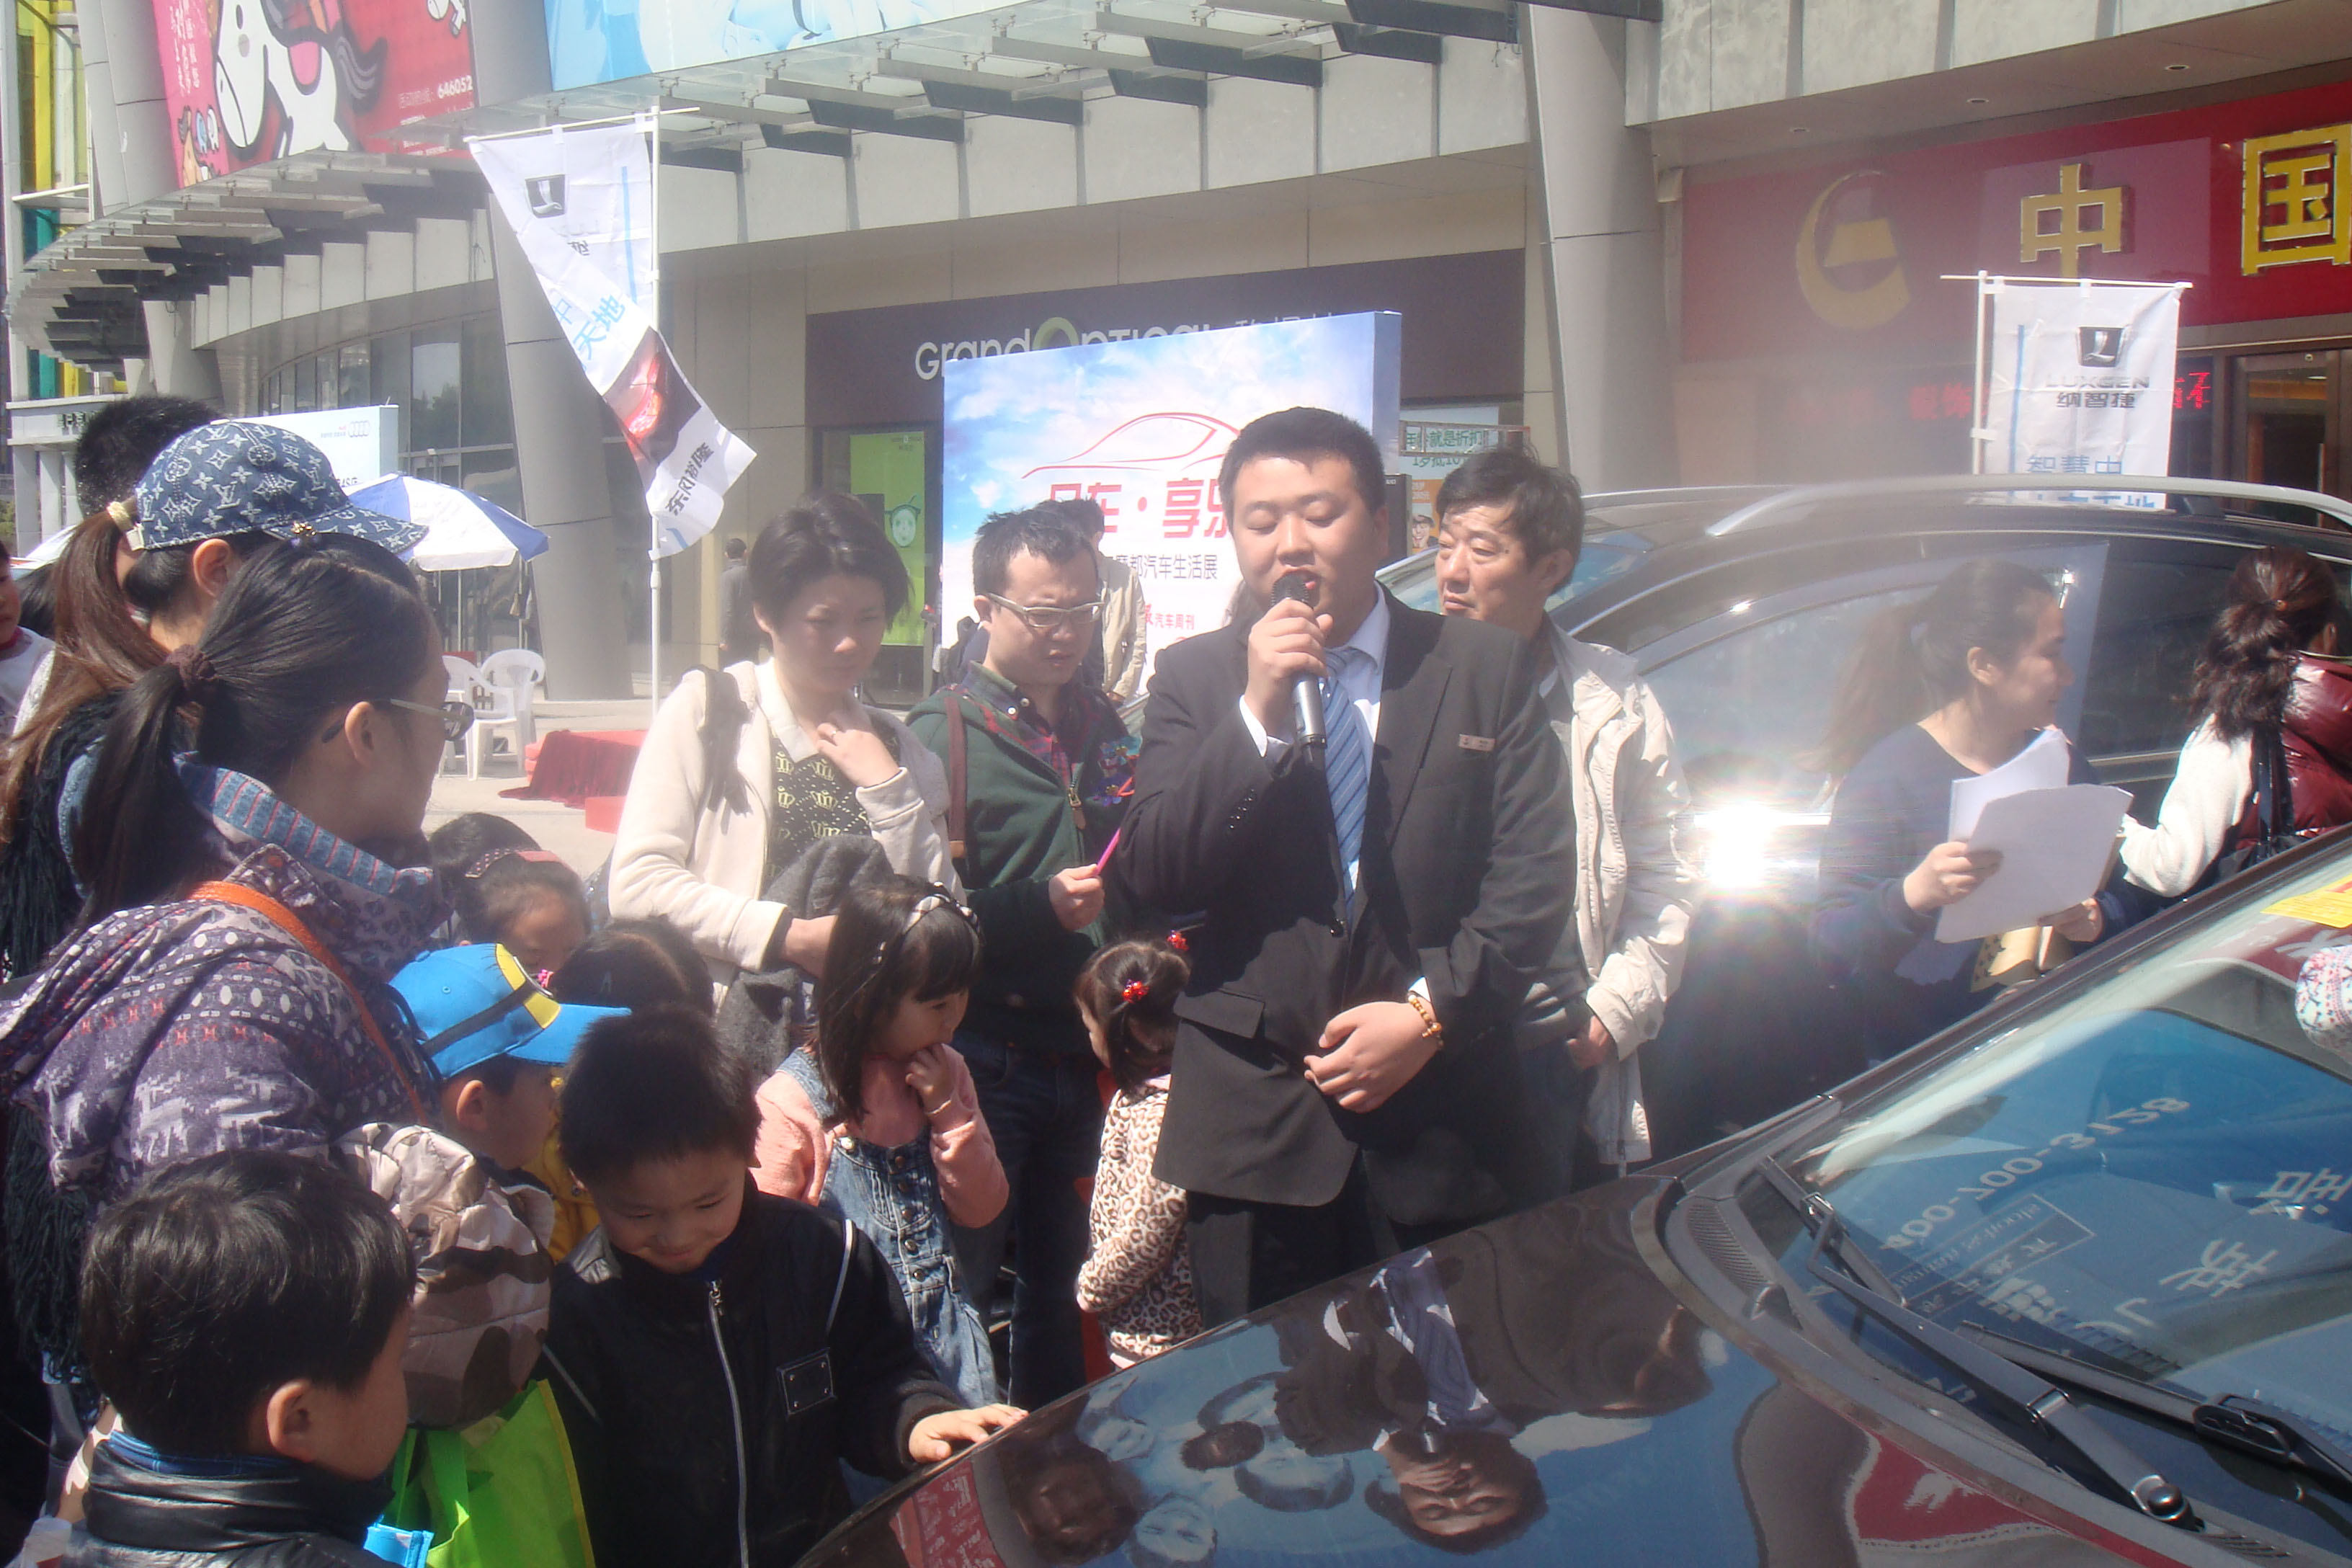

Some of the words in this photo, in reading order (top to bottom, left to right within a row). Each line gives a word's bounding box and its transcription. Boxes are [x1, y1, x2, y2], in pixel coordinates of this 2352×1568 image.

[437, 74, 473, 99] 646052
[2020, 123, 2352, 285] 中国
[914, 317, 1211, 380] GrandO
[2045, 375, 2150, 389] LUXGEN
[2056, 392, 2136, 409] 纳智捷
[664, 442, 715, 517] 东风裕隆
[1108, 553, 1219, 580] 都汽车生活展
